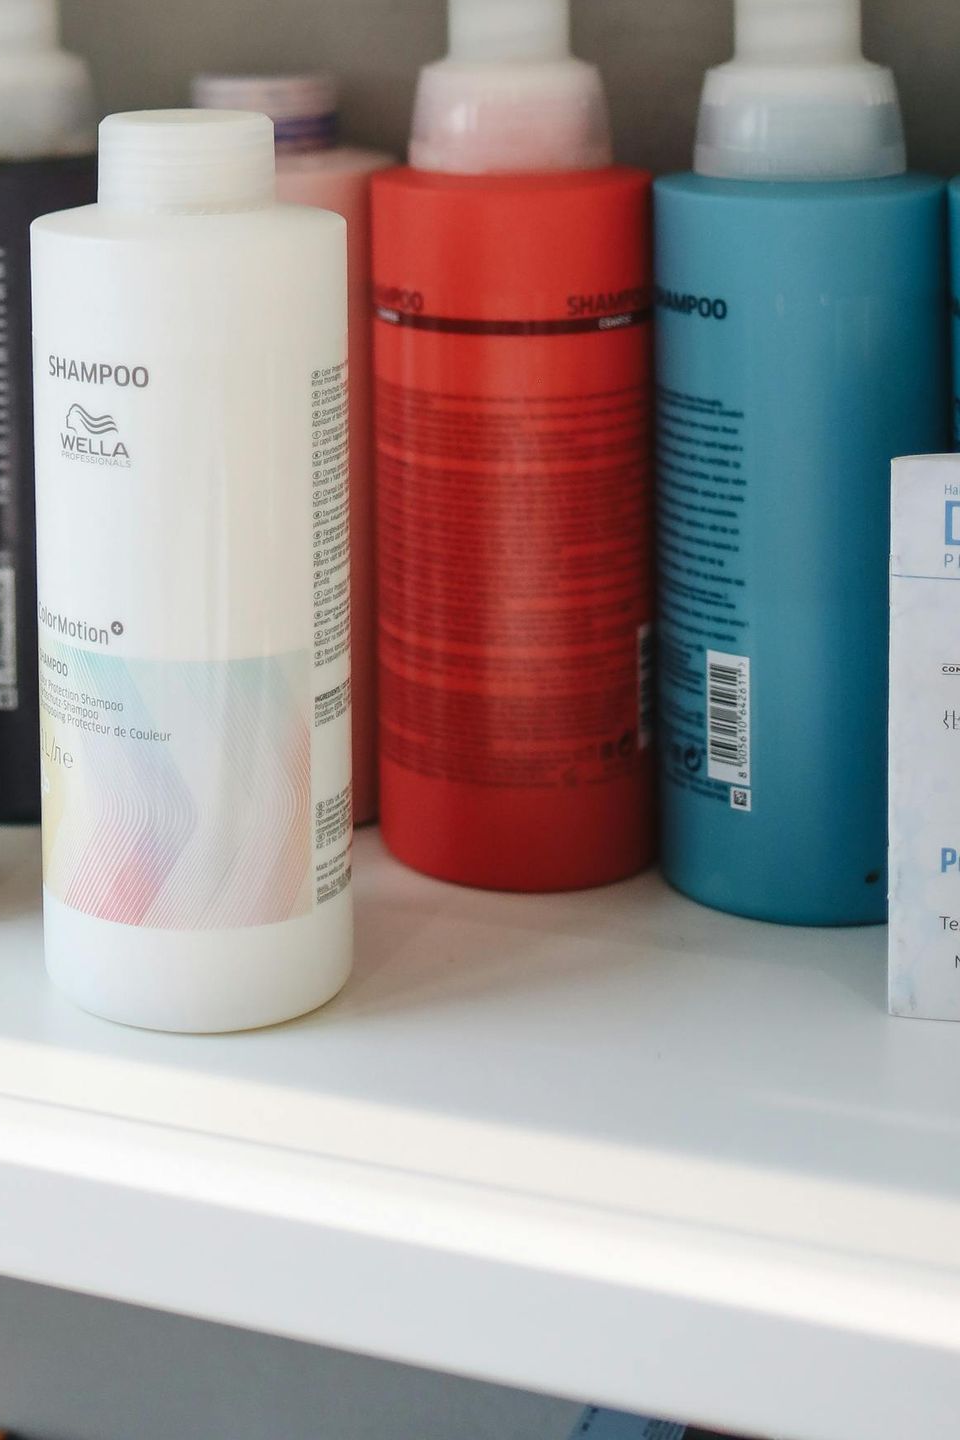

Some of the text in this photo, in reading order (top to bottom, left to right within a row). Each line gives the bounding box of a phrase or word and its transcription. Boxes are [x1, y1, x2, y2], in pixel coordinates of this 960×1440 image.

[48, 354, 150, 389] SHAMPOO
[60, 432, 130, 459] WELLA
[61, 450, 132, 469] PROFESSIONALS
[81, 693, 124, 713] Shampoo
[67, 713, 111, 736] Protecteur
[113, 725, 127, 738] de
[129, 728, 172, 742] Couleur
[939, 915, 960, 931] Te
